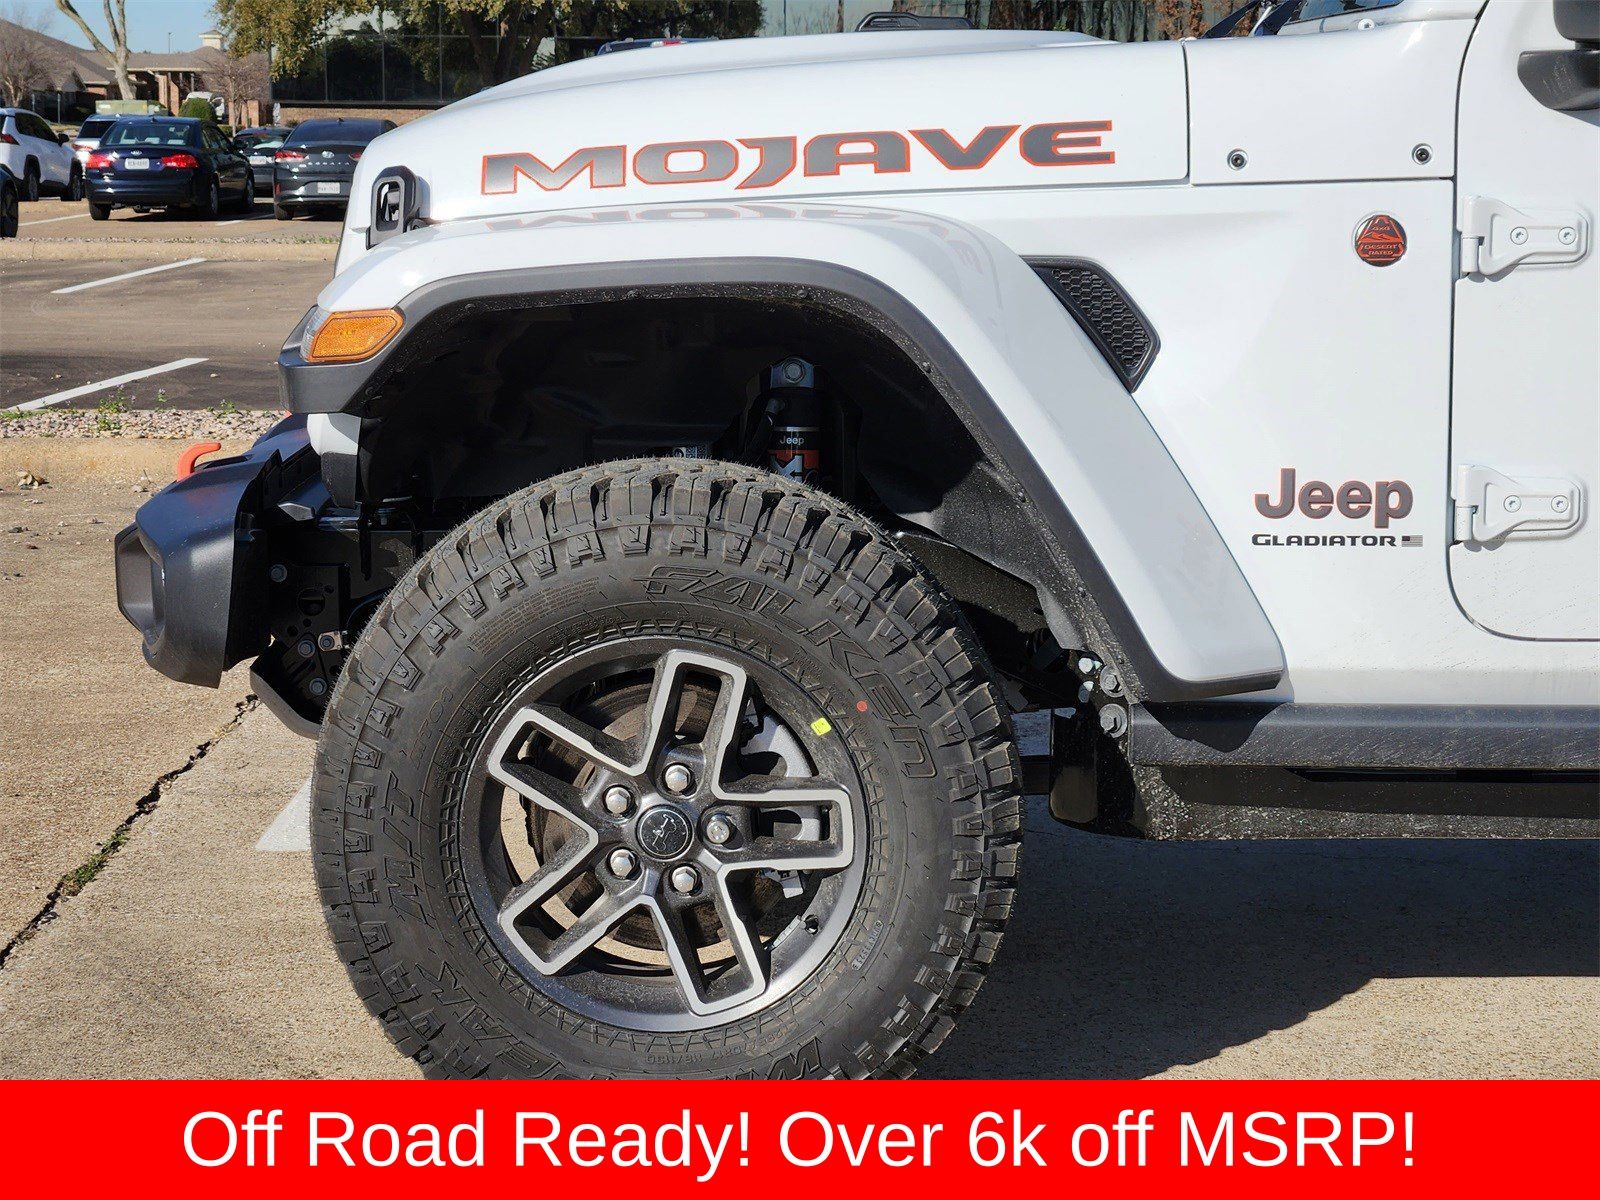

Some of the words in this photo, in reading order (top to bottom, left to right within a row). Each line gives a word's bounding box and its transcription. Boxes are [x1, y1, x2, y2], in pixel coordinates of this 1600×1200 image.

[481, 120, 1116, 195] MOJAVE
[779, 436, 805, 446] Jeep
[1254, 467, 1414, 529] Jeep
[1252, 533, 1397, 546] GLADIATOR
[634, 565, 937, 779] FALKEN
